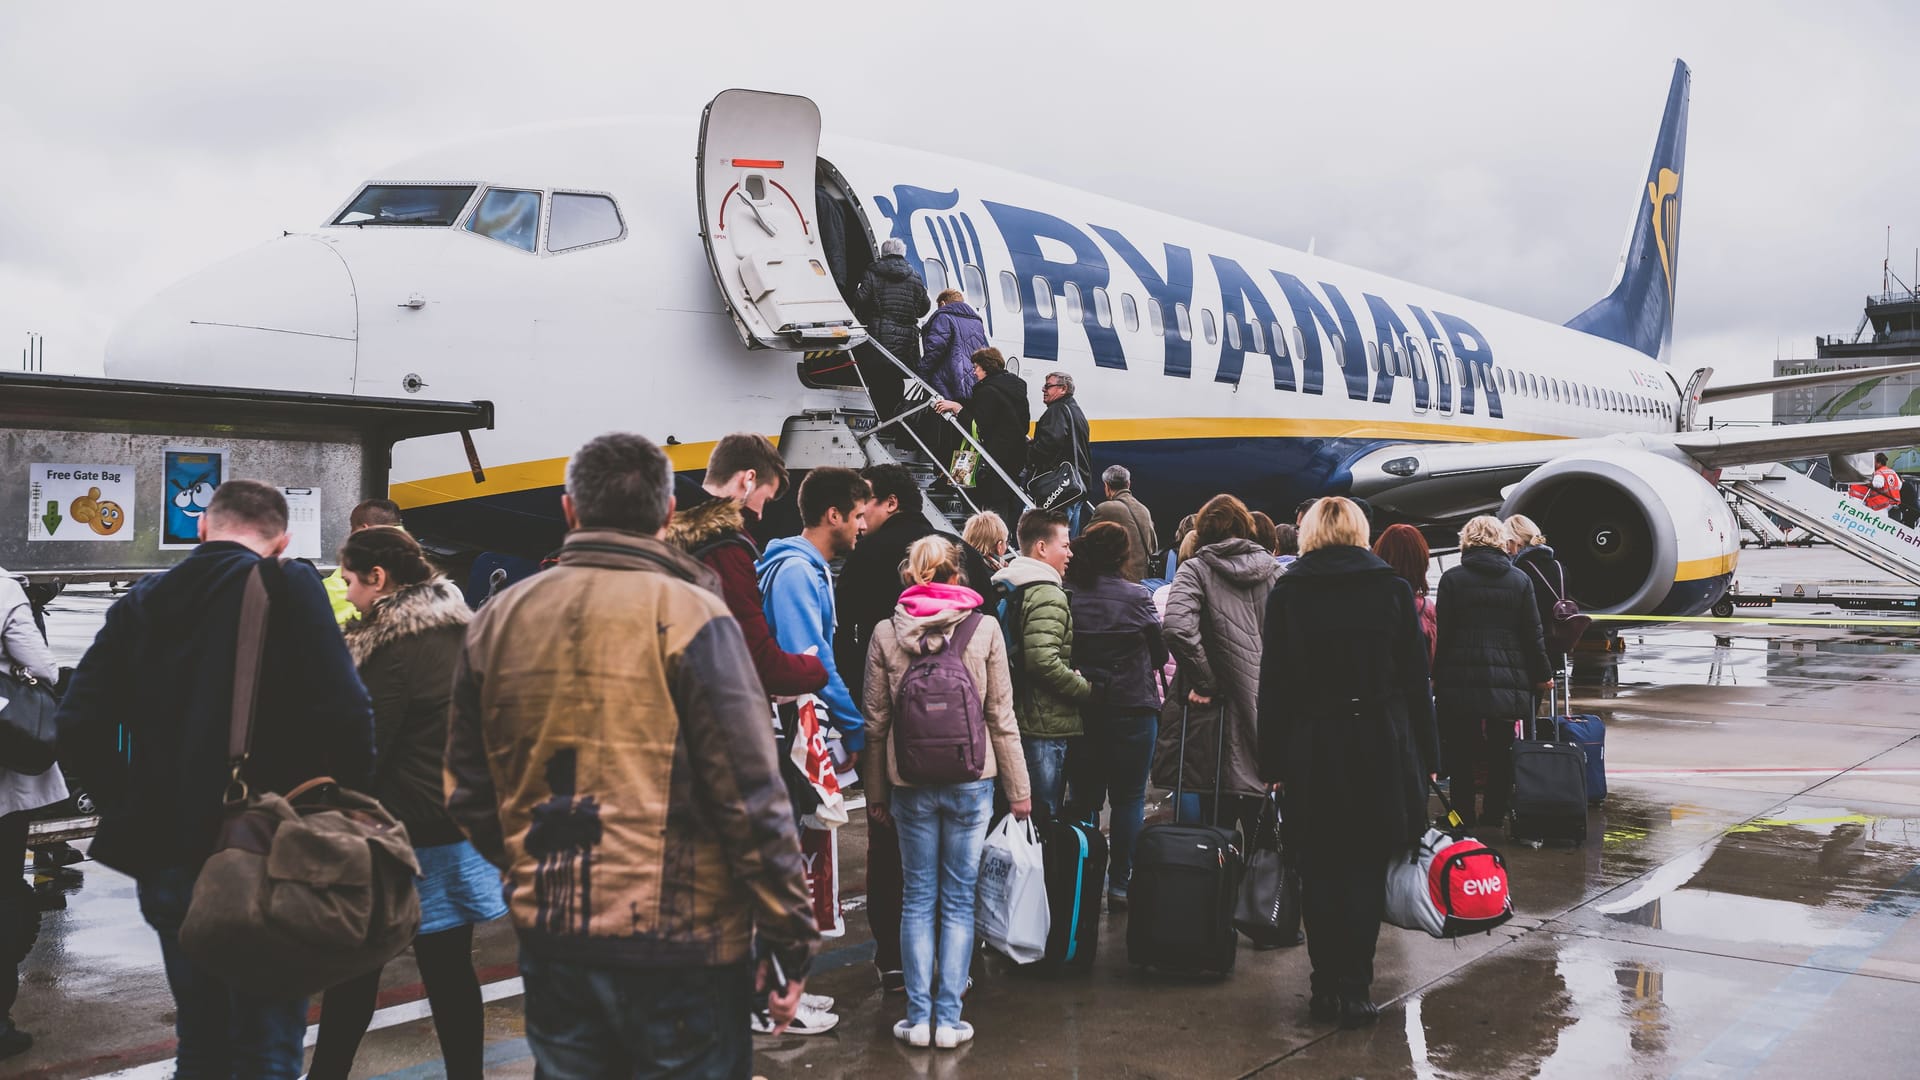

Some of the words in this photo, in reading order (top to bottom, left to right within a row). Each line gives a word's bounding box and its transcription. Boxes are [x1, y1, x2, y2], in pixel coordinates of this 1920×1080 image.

[981, 199, 1504, 419] RYANAIR
[47, 470, 71, 480] Free
[73, 470, 99, 480] Gate
[101, 471, 121, 483] Bag
[1043, 485, 1064, 509] adidas
[1832, 512, 1876, 538] airport
[1838, 500, 1896, 535] frankfurt
[1463, 875, 1502, 896] ewe
